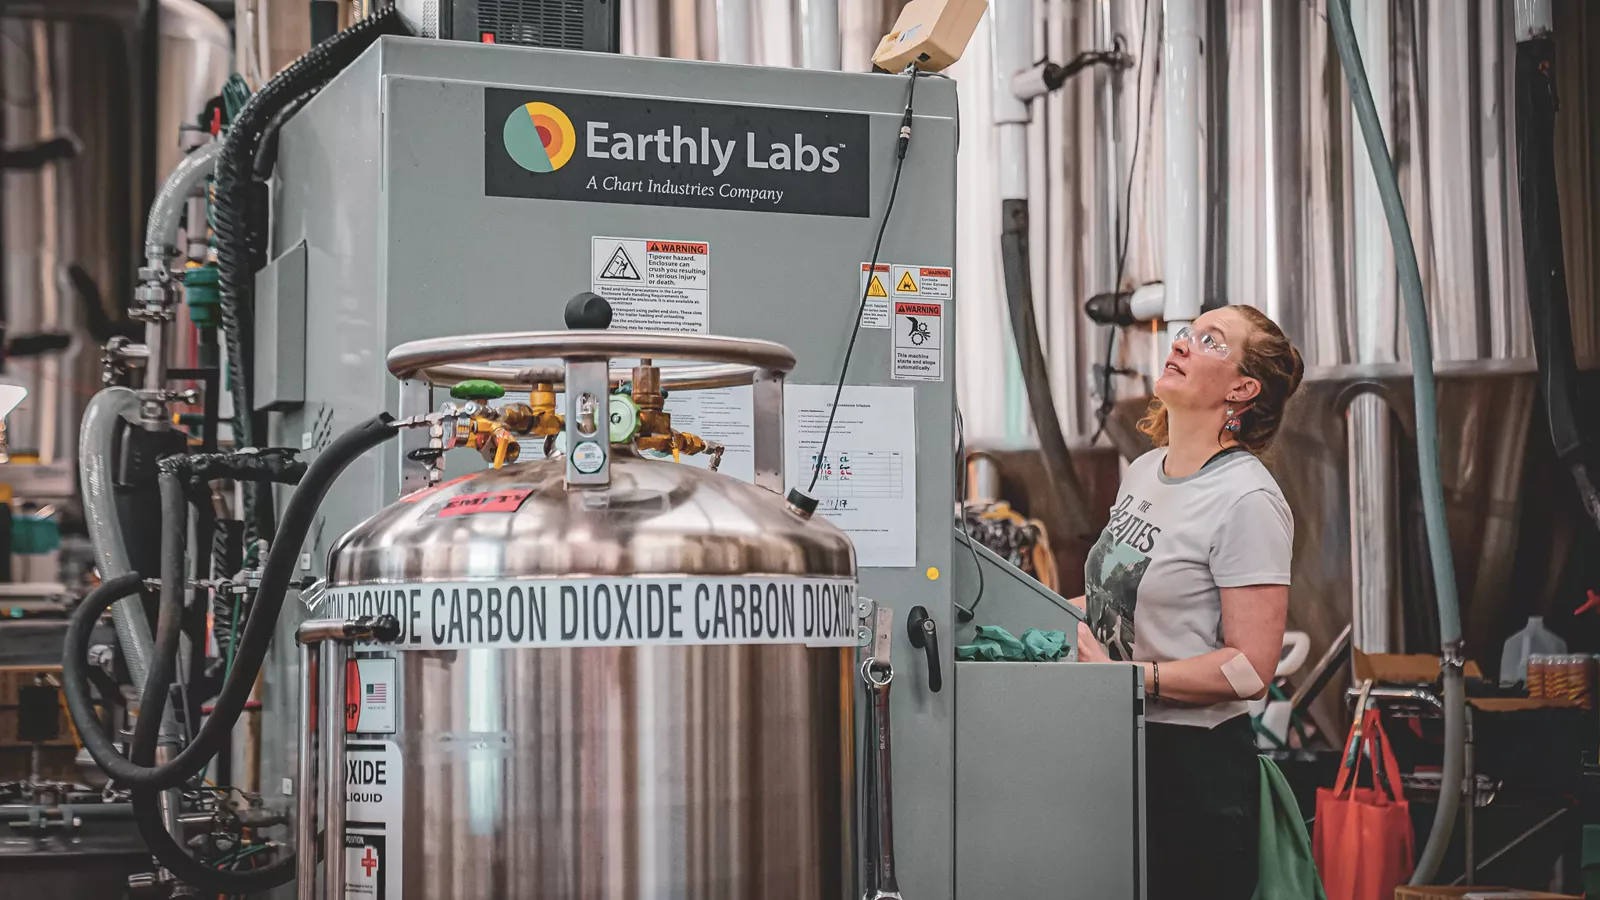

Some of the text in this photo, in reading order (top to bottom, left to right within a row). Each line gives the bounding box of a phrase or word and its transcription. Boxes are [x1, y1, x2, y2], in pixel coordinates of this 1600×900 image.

[586, 121, 736, 176] Earthly
[586, 177, 784, 204] A Chart Industries Company
[661, 244, 704, 254] WARNING
[906, 306, 938, 314] WARNING
[1137, 500, 1152, 514] THE
[431, 586, 548, 645] CARBON
[560, 584, 683, 642] DIOXIDE
[694, 583, 796, 640] CARBON
[803, 583, 854, 638] DIOXIDE
[346, 760, 386, 785] XIDE
